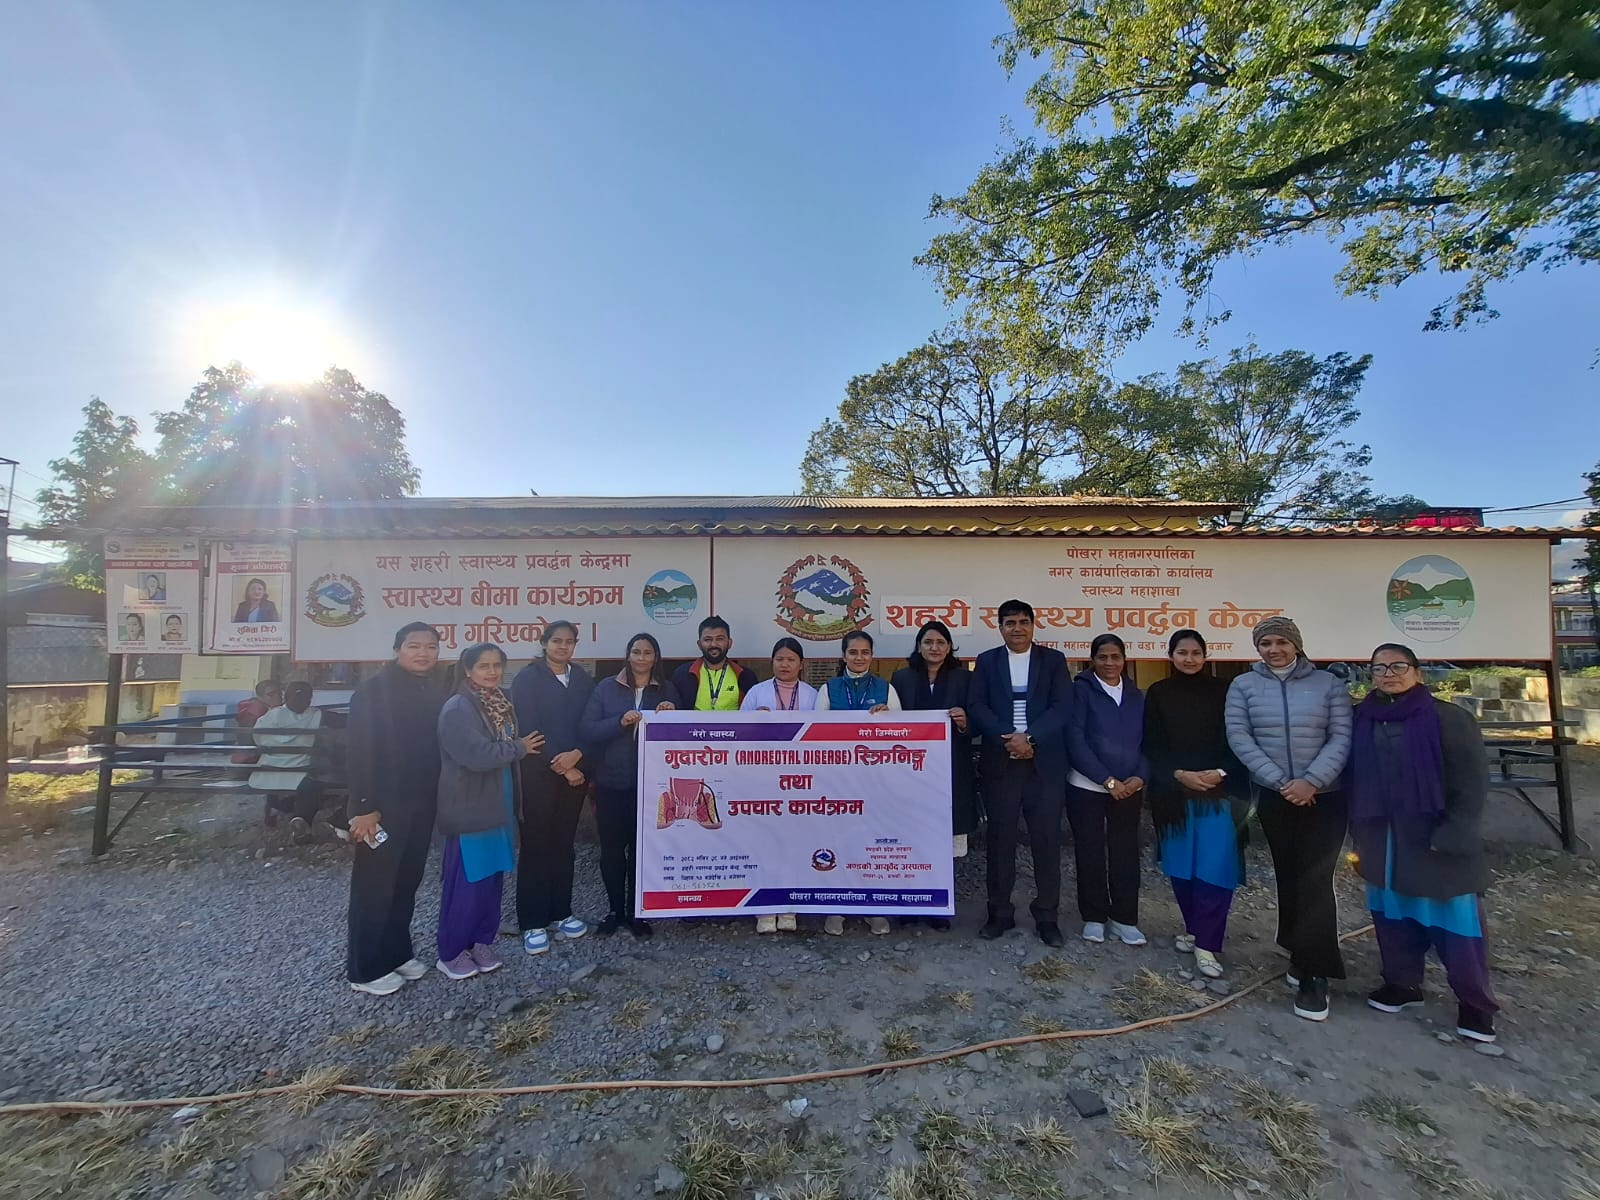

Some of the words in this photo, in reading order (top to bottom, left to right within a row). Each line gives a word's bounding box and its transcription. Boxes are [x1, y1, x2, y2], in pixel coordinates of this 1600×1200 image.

[376, 556, 402, 570] यस
[409, 552, 451, 573] शहरी
[459, 555, 518, 572] स्वास्थ्य
[579, 550, 631, 571] केन्द्रमा
[1067, 546, 1103, 560] पोखरा
[1108, 545, 1195, 561] महानगरपालिका
[1049, 568, 1075, 579] नगर
[1079, 563, 1161, 579] कार्यपालिकाको
[1166, 565, 1214, 579] कार्यालय
[382, 586, 464, 609] स्वास्थ्य
[470, 580, 520, 607] बीमा
[527, 579, 625, 608] कार्यक्रम
[1081, 586, 1124, 598] स्वास्थ्य
[1130, 586, 1182, 598] महाशाखा
[886, 598, 971, 629] शहरी
[664, 744, 729, 770] गुदारोग
[803, 749, 852, 766] DISEASE)
[779, 774, 813, 791] तथा
[728, 799, 783, 816] उपचार
[788, 796, 865, 816] कार्यक्रम
